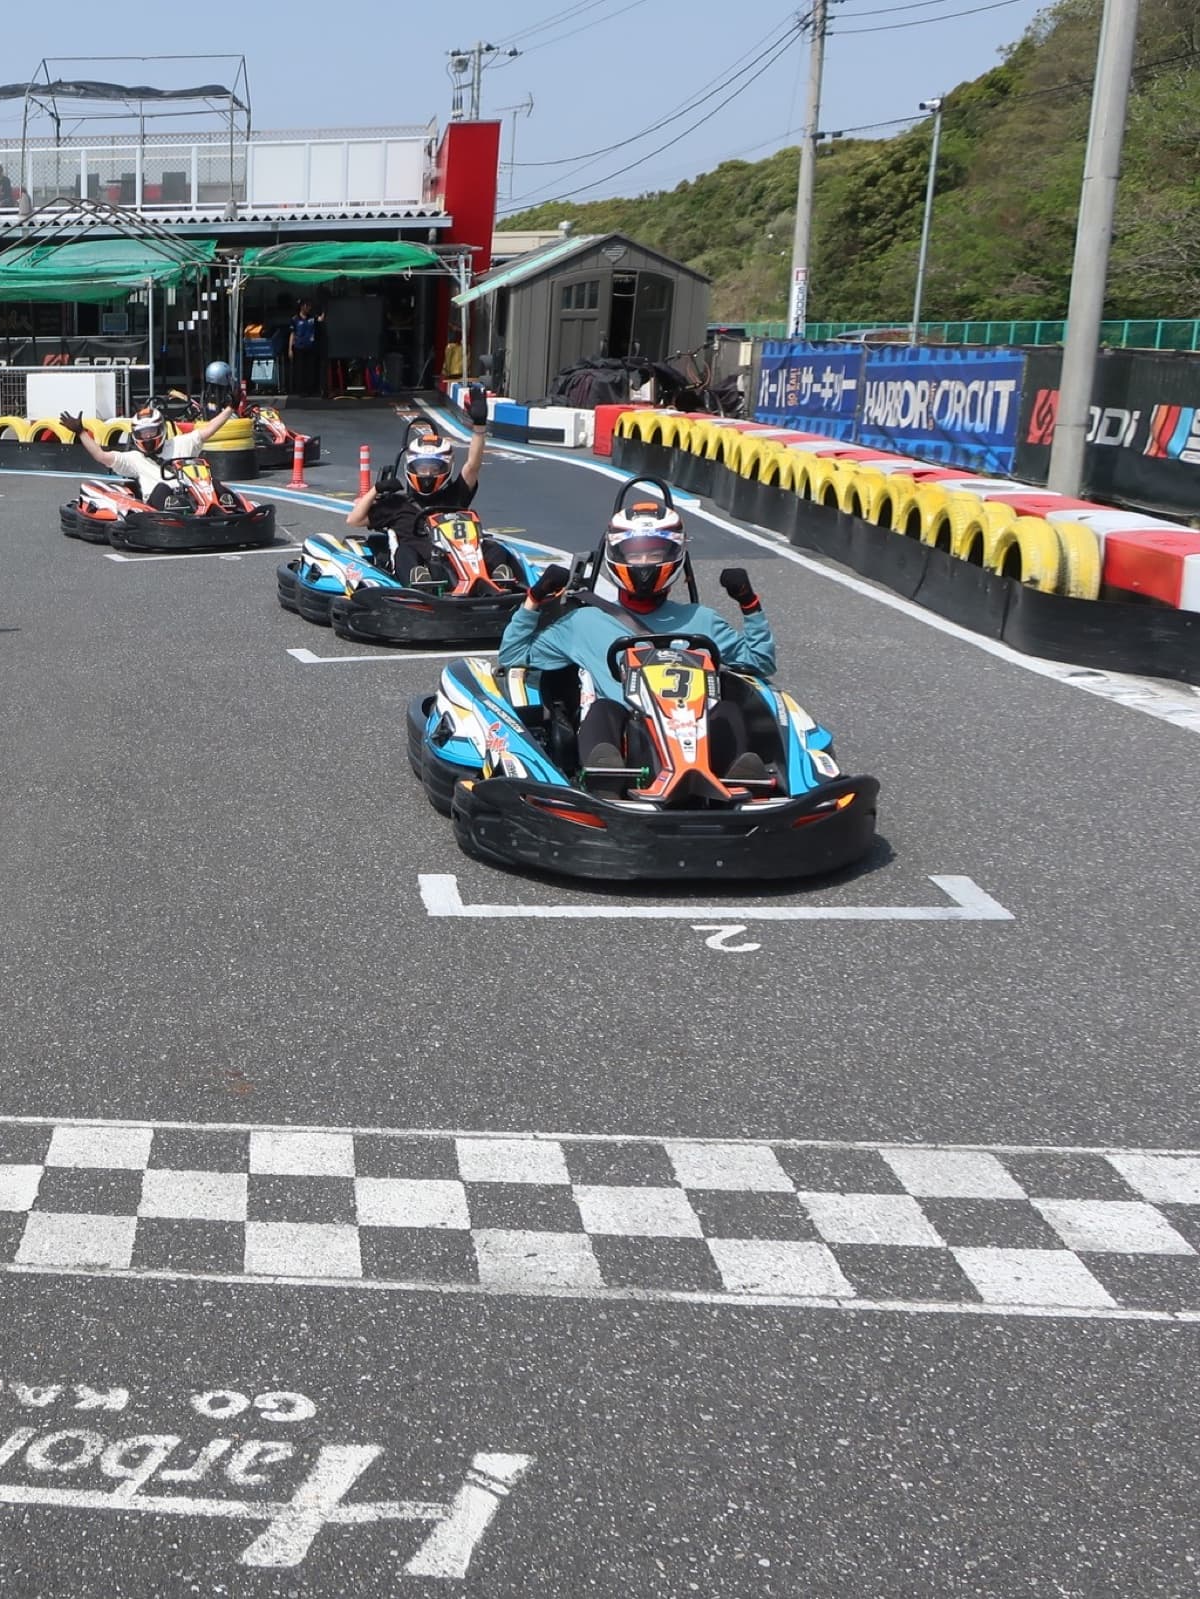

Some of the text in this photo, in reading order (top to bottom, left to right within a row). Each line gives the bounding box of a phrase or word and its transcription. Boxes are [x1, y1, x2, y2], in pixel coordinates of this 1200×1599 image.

[453, 522, 467, 539] 8
[661, 668, 693, 699] 3
[689, 924, 762, 952] 2
[191, 1390, 317, 1422] GO
